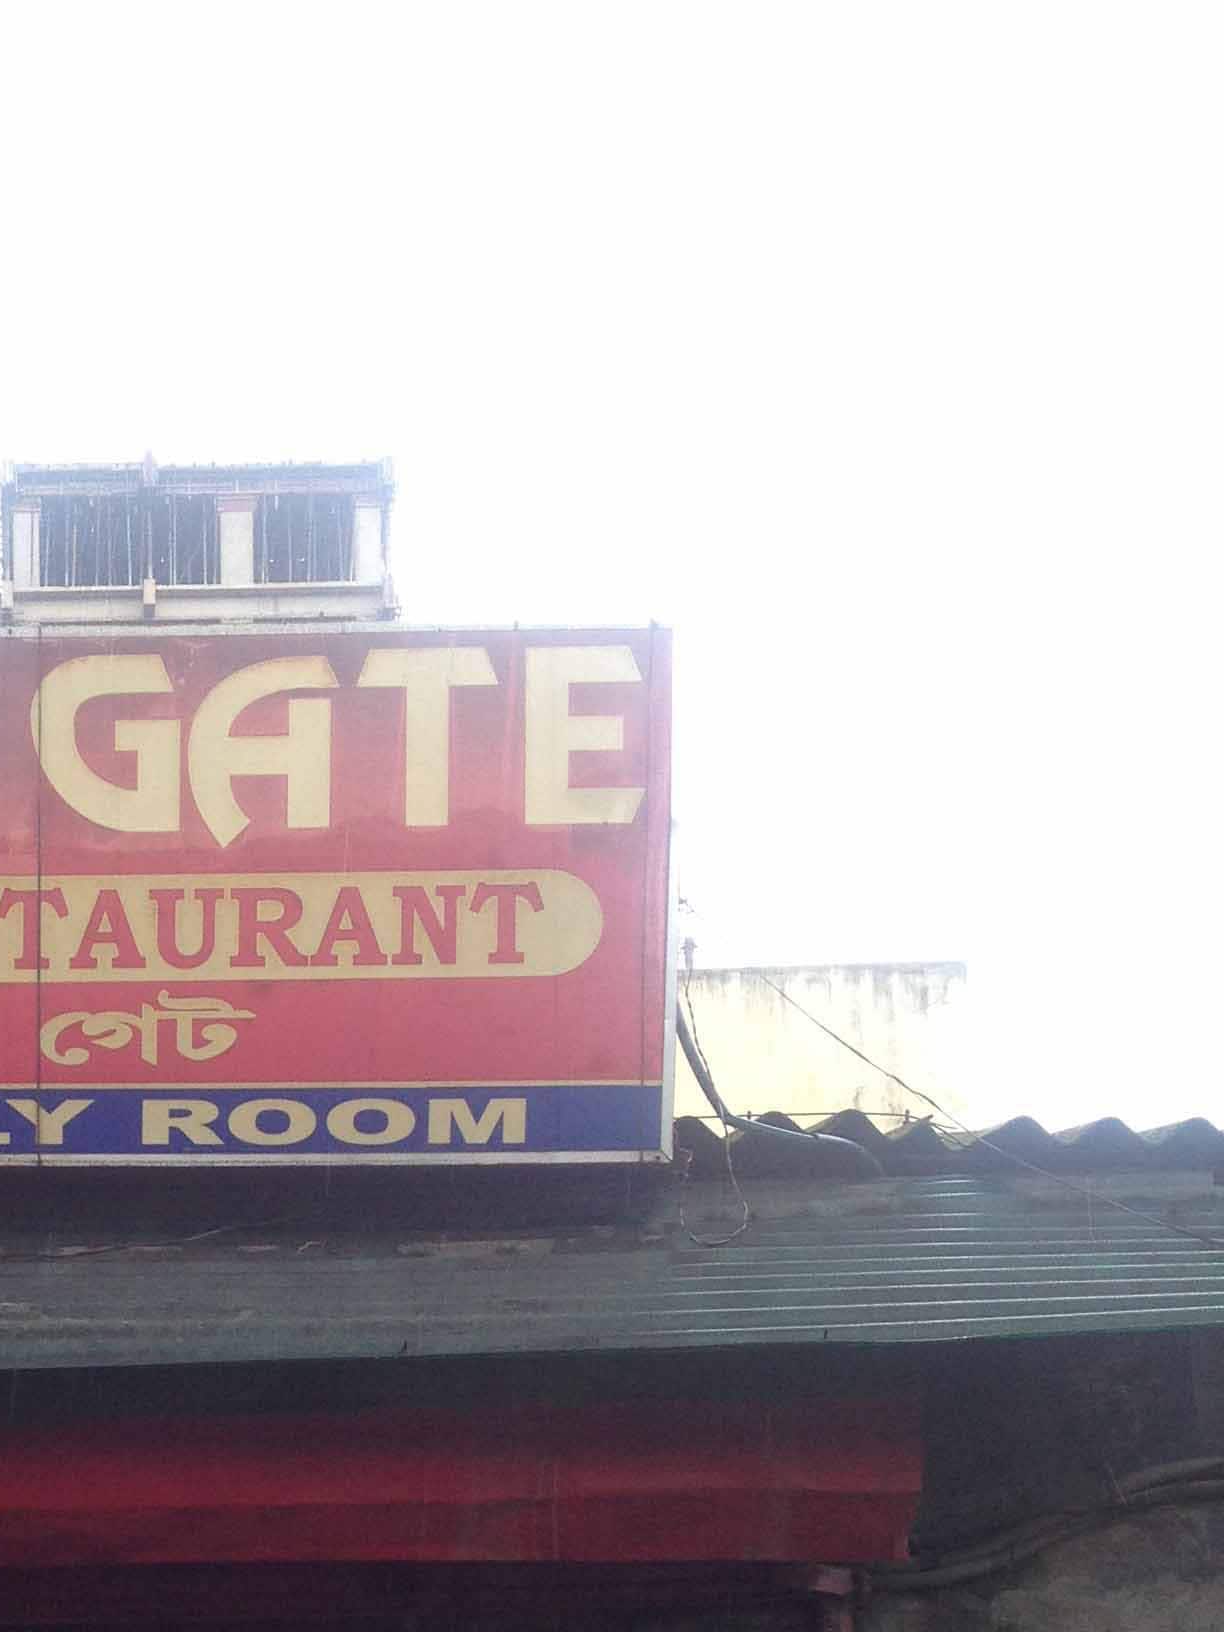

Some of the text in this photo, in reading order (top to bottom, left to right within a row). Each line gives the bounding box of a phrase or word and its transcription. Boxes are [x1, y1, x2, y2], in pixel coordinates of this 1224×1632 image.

[30, 645, 646, 849] GATE
[39, 989, 257, 1067] গেট
[141, 1097, 527, 1146] ROOM
